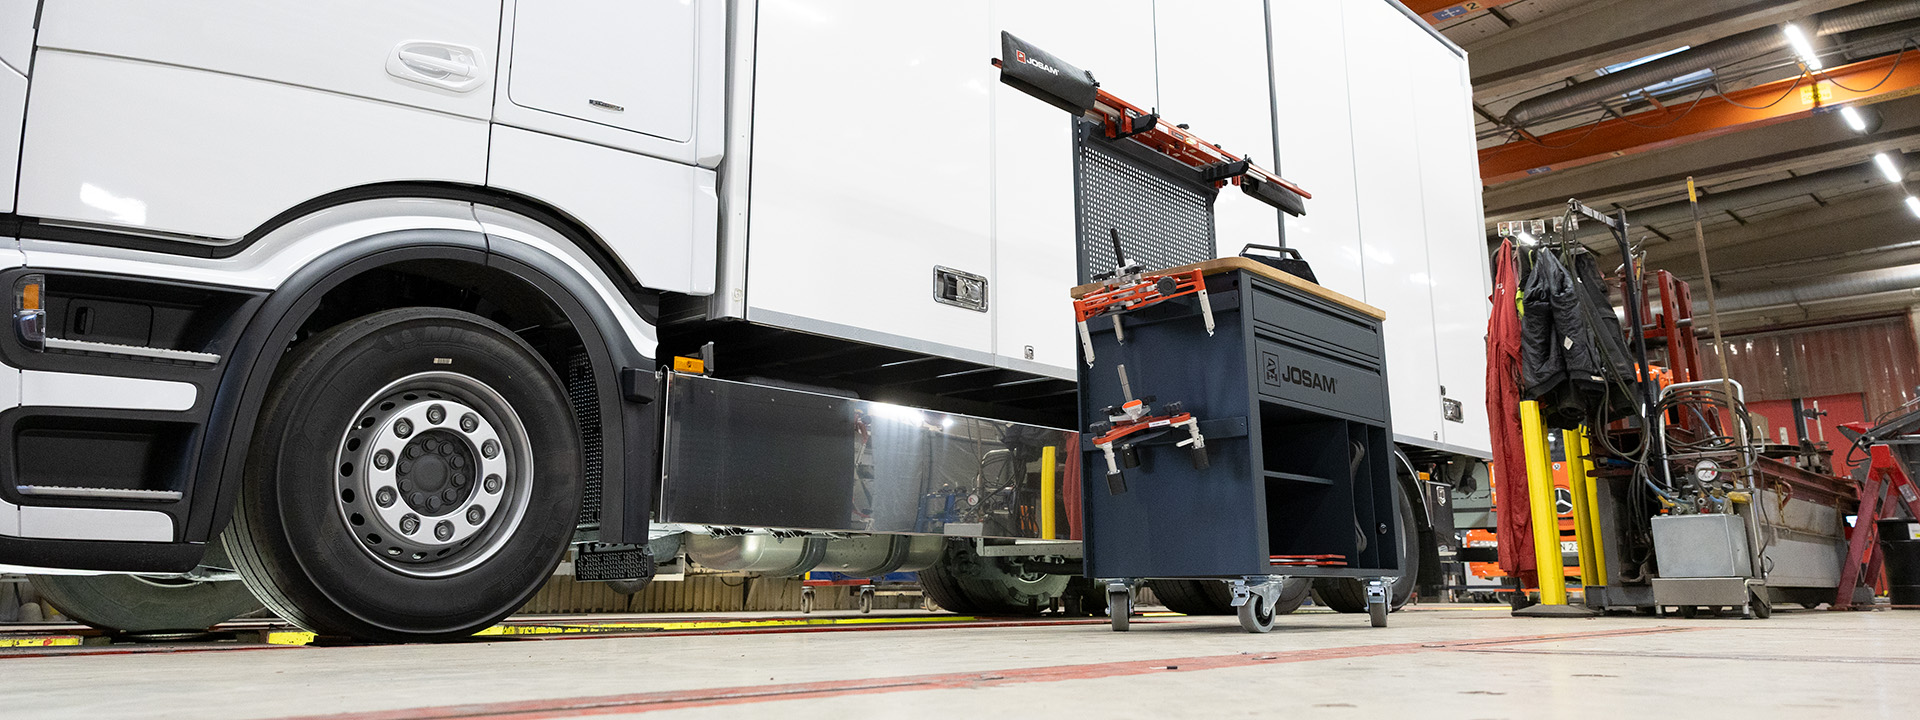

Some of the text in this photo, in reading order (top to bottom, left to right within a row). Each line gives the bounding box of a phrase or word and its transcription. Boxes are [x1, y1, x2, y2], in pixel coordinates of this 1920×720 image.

[1466, 2, 1480, 10] 2
[1026, 57, 1059, 76] JOSAM
[1282, 365, 1336, 395] JOSAM
